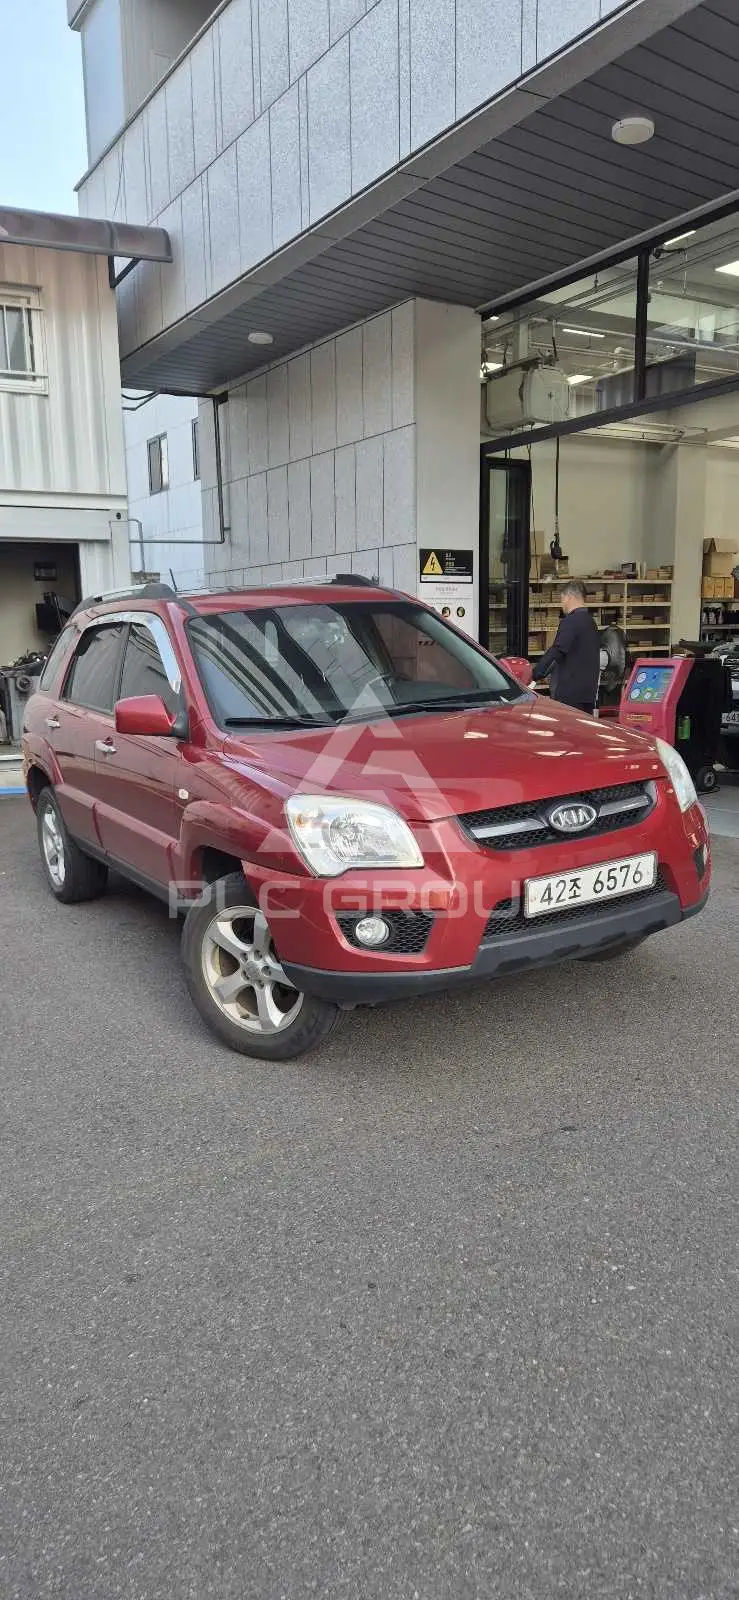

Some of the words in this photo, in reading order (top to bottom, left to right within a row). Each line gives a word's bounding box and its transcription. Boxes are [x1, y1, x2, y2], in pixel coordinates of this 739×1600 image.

[558, 807, 591, 826] KIA
[540, 878, 581, 906] 42조
[593, 862, 643, 894] 6576
